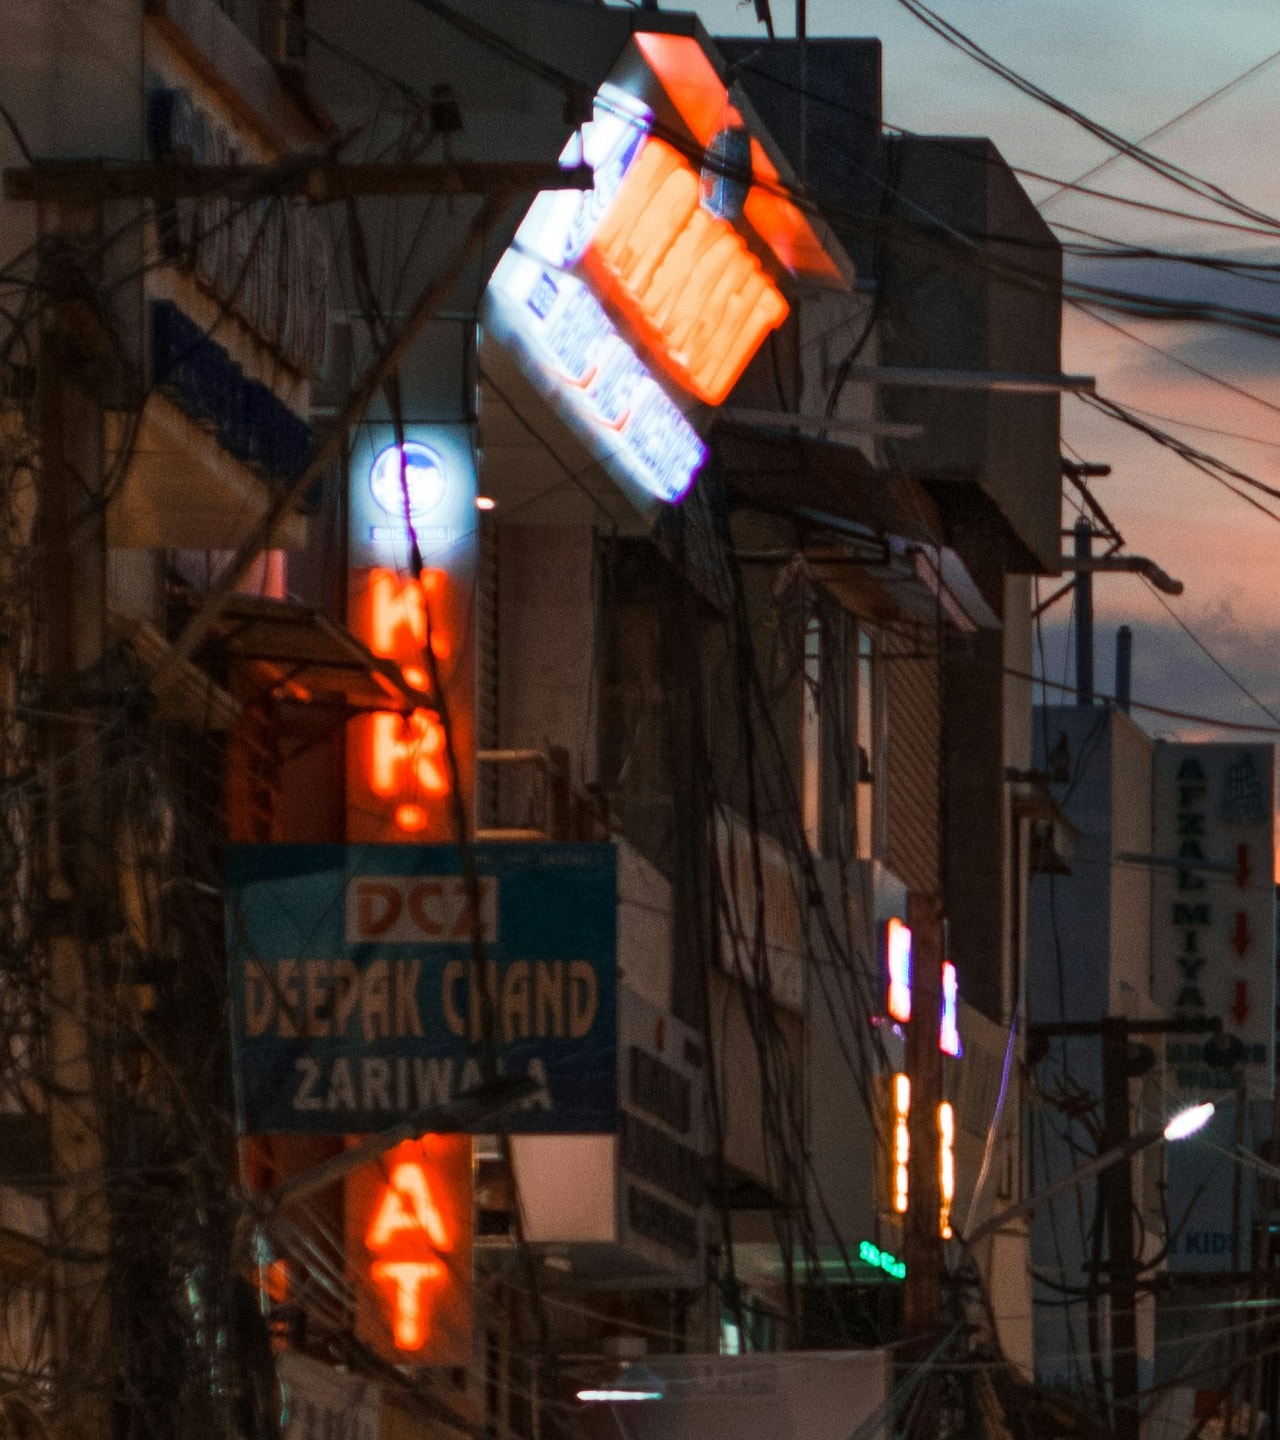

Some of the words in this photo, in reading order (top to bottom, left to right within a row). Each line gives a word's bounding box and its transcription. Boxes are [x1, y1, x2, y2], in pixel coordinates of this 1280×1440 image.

[355, 883, 489, 937] DCZ
[243, 958, 425, 1043] DEEPAK
[441, 958, 600, 1044] CHAND
[291, 1057, 555, 1113] ZARIWAA
[1185, 1232, 1233, 1254] KID
